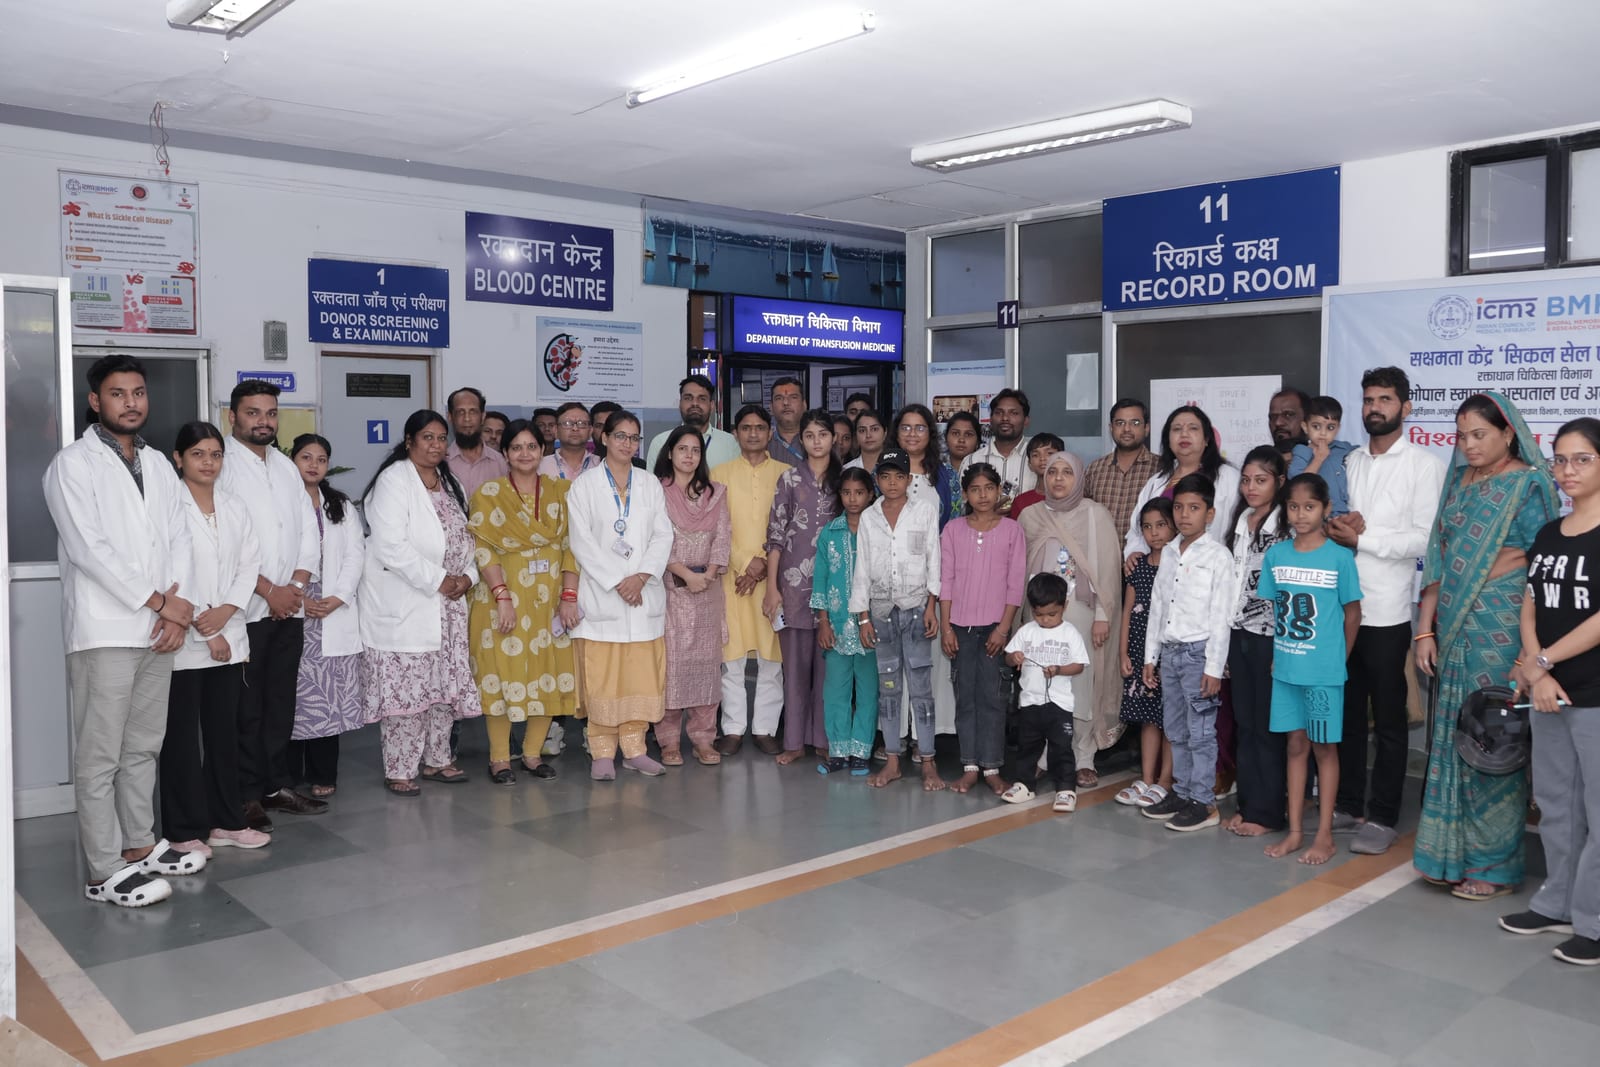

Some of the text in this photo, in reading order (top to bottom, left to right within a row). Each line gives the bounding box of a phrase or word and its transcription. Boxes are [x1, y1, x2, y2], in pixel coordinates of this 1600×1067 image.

[1199, 192, 1229, 223] 11
[87, 211, 103, 219] What
[112, 213, 131, 222] Sickle
[133, 215, 144, 223] Cell
[145, 216, 173, 225] Disease?
[561, 234, 603, 272] केन्द्र
[1153, 234, 1279, 272] रिकार्ड कक्ष
[126, 273, 144, 285] VS
[376, 268, 385, 285] 1
[474, 267, 606, 301] BLOOD CENTRE
[1121, 263, 1316, 304] RECORD ROOM
[312, 291, 360, 307] रक्तदाता
[391, 292, 407, 311] एवं
[410, 292, 446, 312] परीक्षण
[320, 312, 439, 330] DONOR SCREENING
[807, 312, 849, 332] चिकित्सा
[852, 315, 881, 334] विभाग
[1000, 304, 1016, 325] 11
[332, 326, 429, 343] & EXAMINATION
[746, 333, 896, 353] DEPARTMENT OF TRANSFUSION MEDICINE
[1410, 351, 1464, 367] सक्षमता
[1467, 344, 1494, 367] केंद्र
[1560, 340, 1592, 362] सेल
[1560, 366, 1593, 380] विभाग
[1450, 387, 1494, 401] स्मा
[1560, 384, 1581, 400] एवं
[1584, 386, 1600, 400] अ
[373, 422, 383, 440] 1
[1289, 569, 1323, 582] LITTLE
